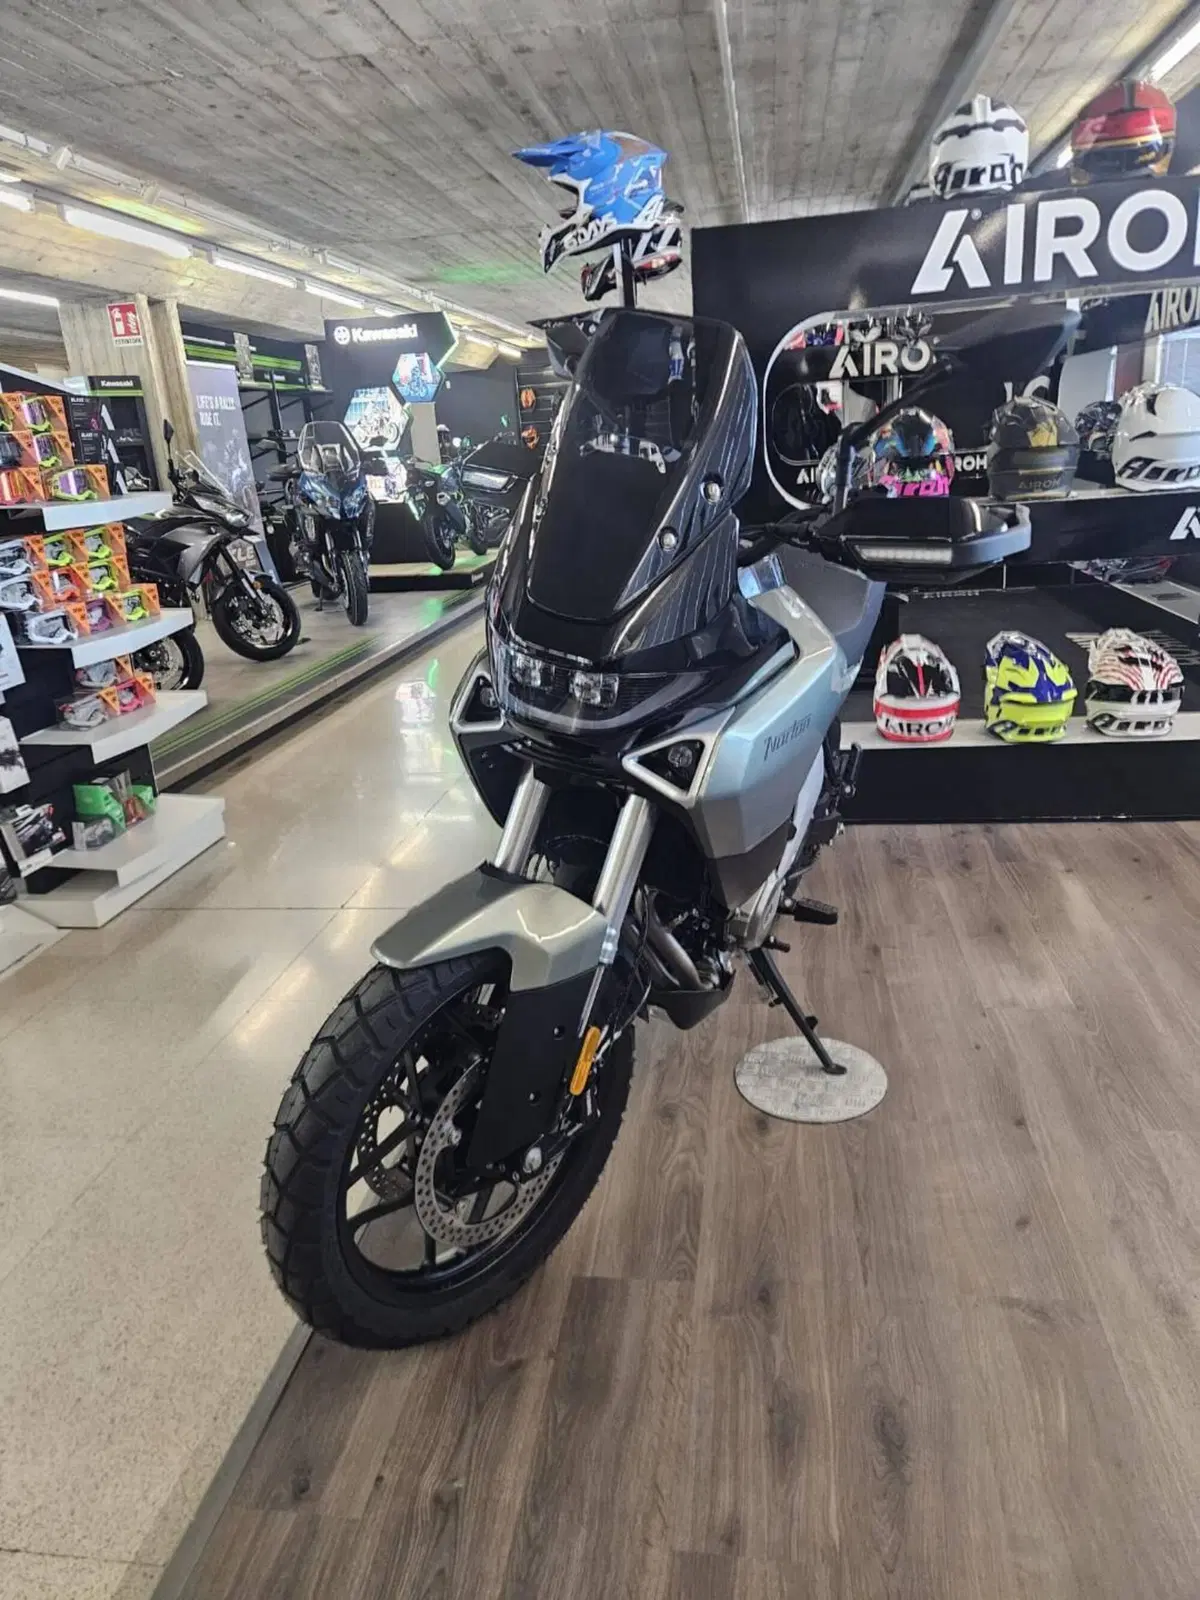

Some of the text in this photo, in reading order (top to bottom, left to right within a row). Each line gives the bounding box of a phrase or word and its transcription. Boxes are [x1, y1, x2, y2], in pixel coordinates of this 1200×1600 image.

[911, 189, 1200, 294] AIRO
[351, 323, 418, 343] Kawasaki
[829, 337, 939, 379] AIRO
[1118, 456, 1200, 481] Airo
